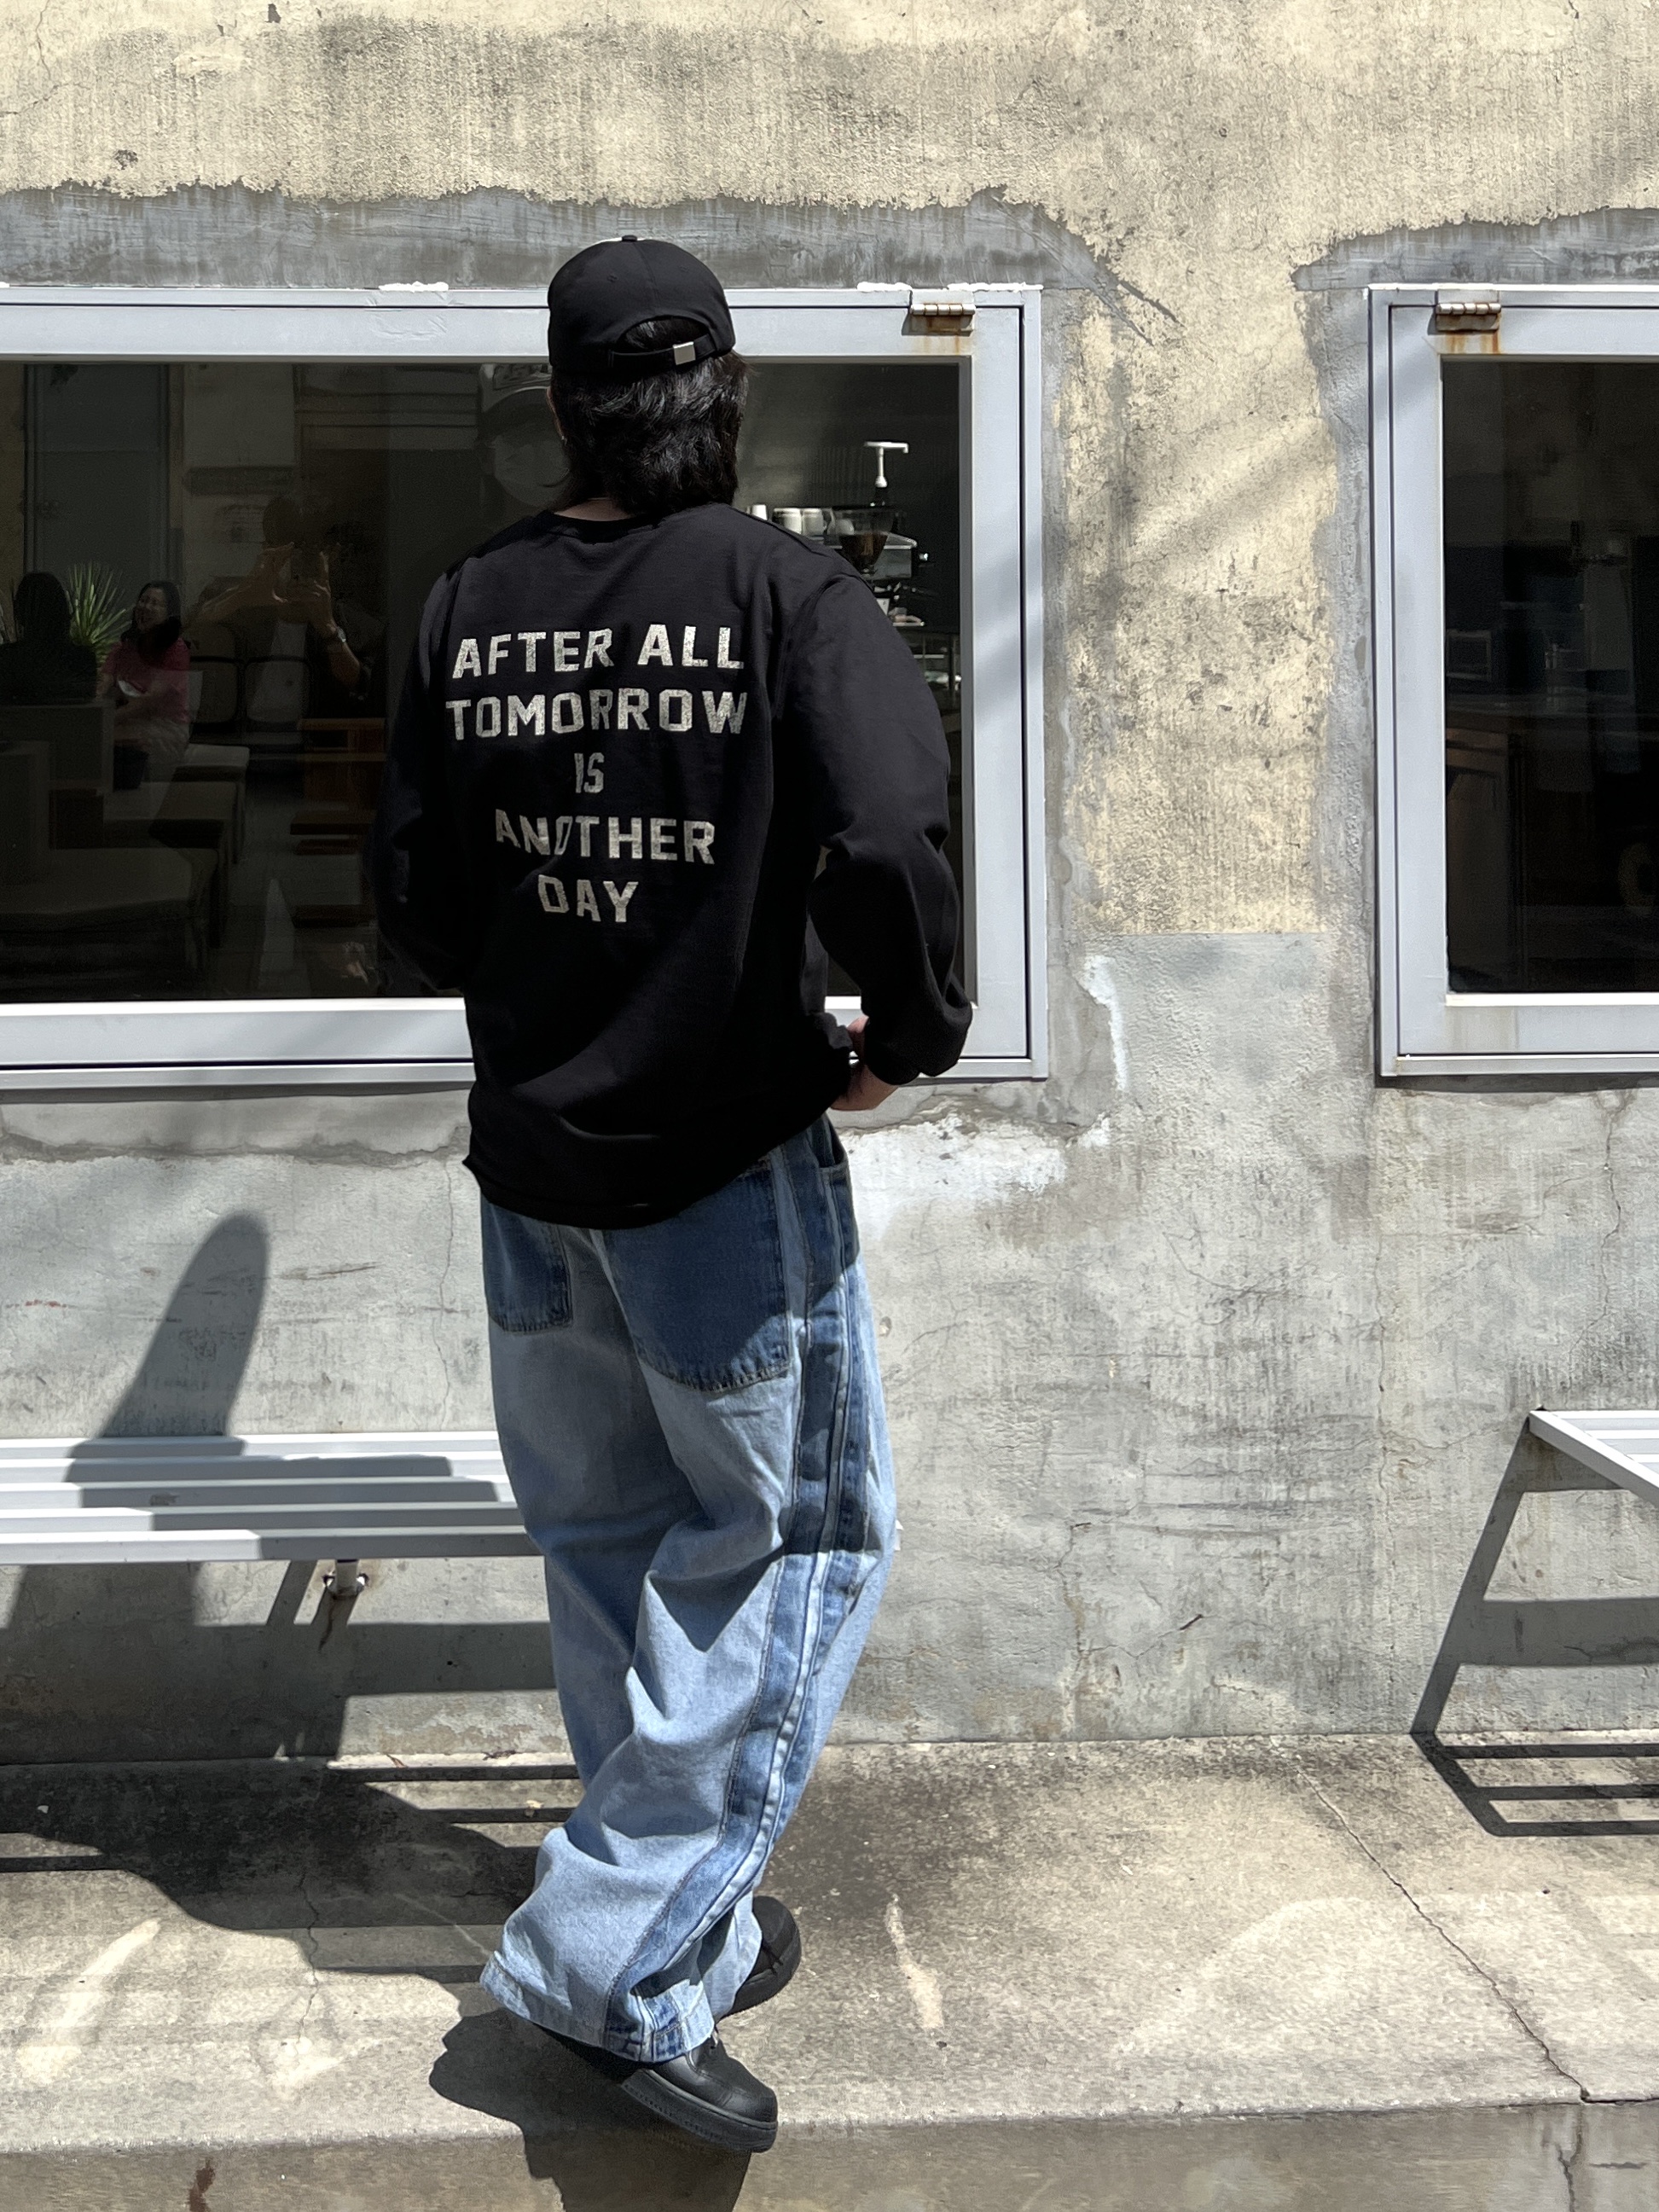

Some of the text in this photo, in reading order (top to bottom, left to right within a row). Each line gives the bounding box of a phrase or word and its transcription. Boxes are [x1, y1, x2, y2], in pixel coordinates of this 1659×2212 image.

[452, 624, 744, 679] AFTER ALL
[445, 688, 747, 740] TOMORROW
[574, 752, 605, 793] IS
[496, 808, 716, 864] ANOTHER
[538, 874, 639, 923] DAY
